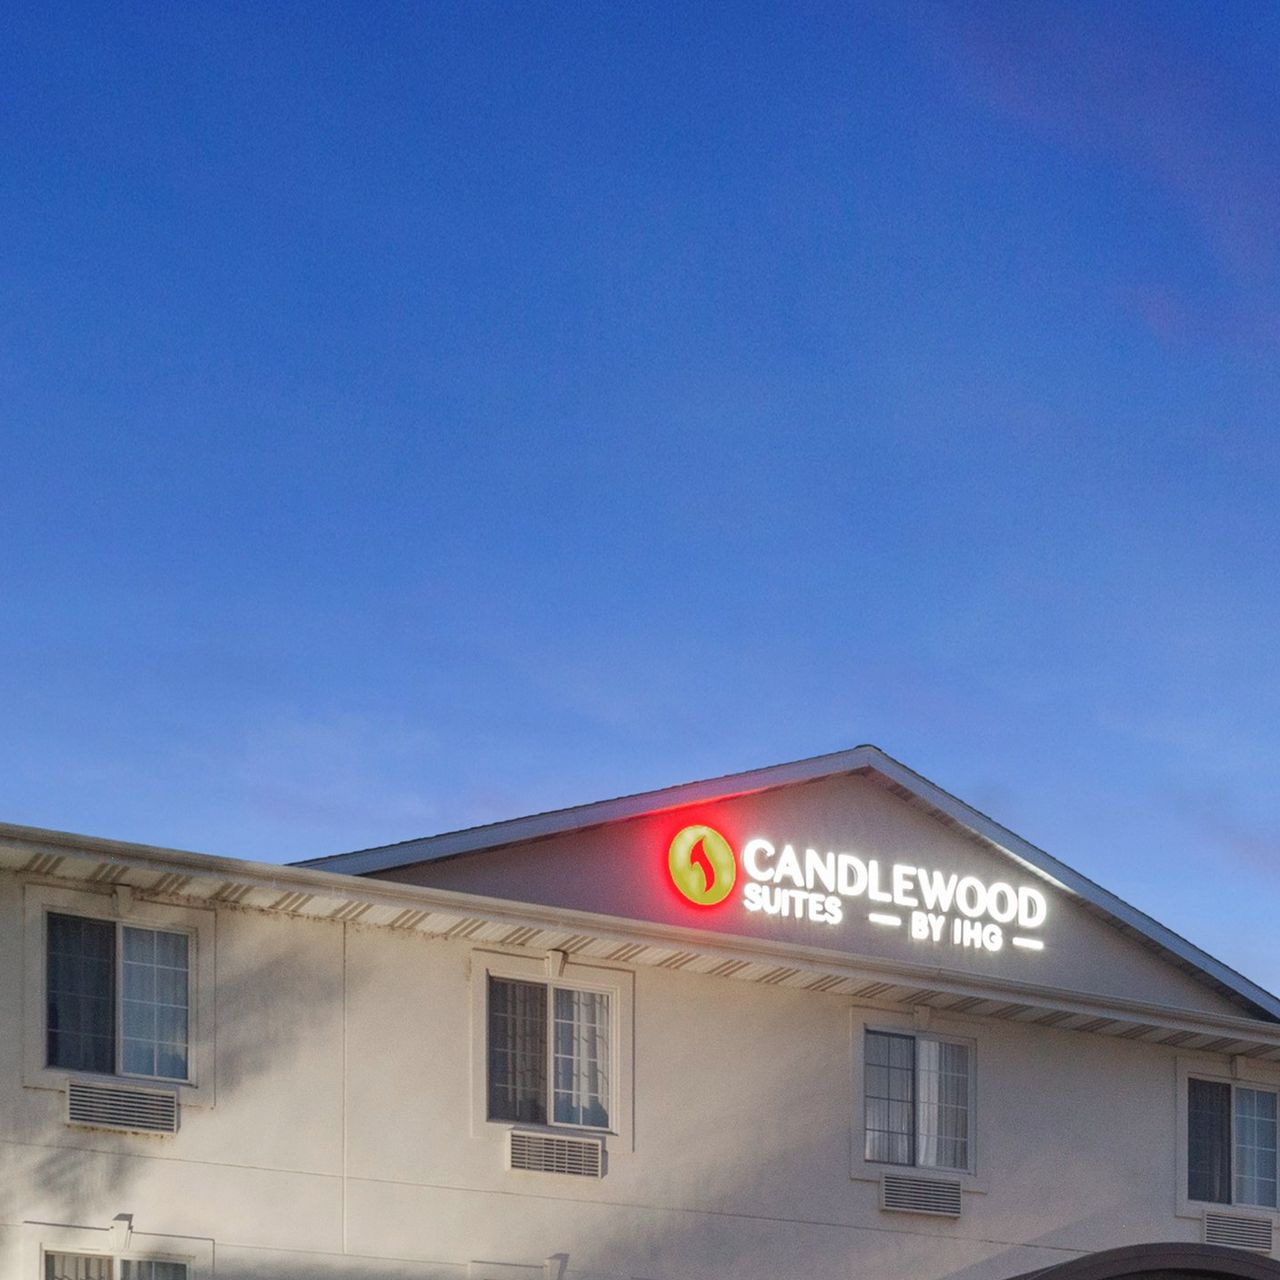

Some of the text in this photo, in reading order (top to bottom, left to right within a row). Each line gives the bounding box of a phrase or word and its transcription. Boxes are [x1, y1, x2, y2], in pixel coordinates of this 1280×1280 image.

[743, 839, 1047, 927] CANDLEWOOD
[744, 883, 842, 925] SUITES
[912, 912, 1003, 951] BY IHG
